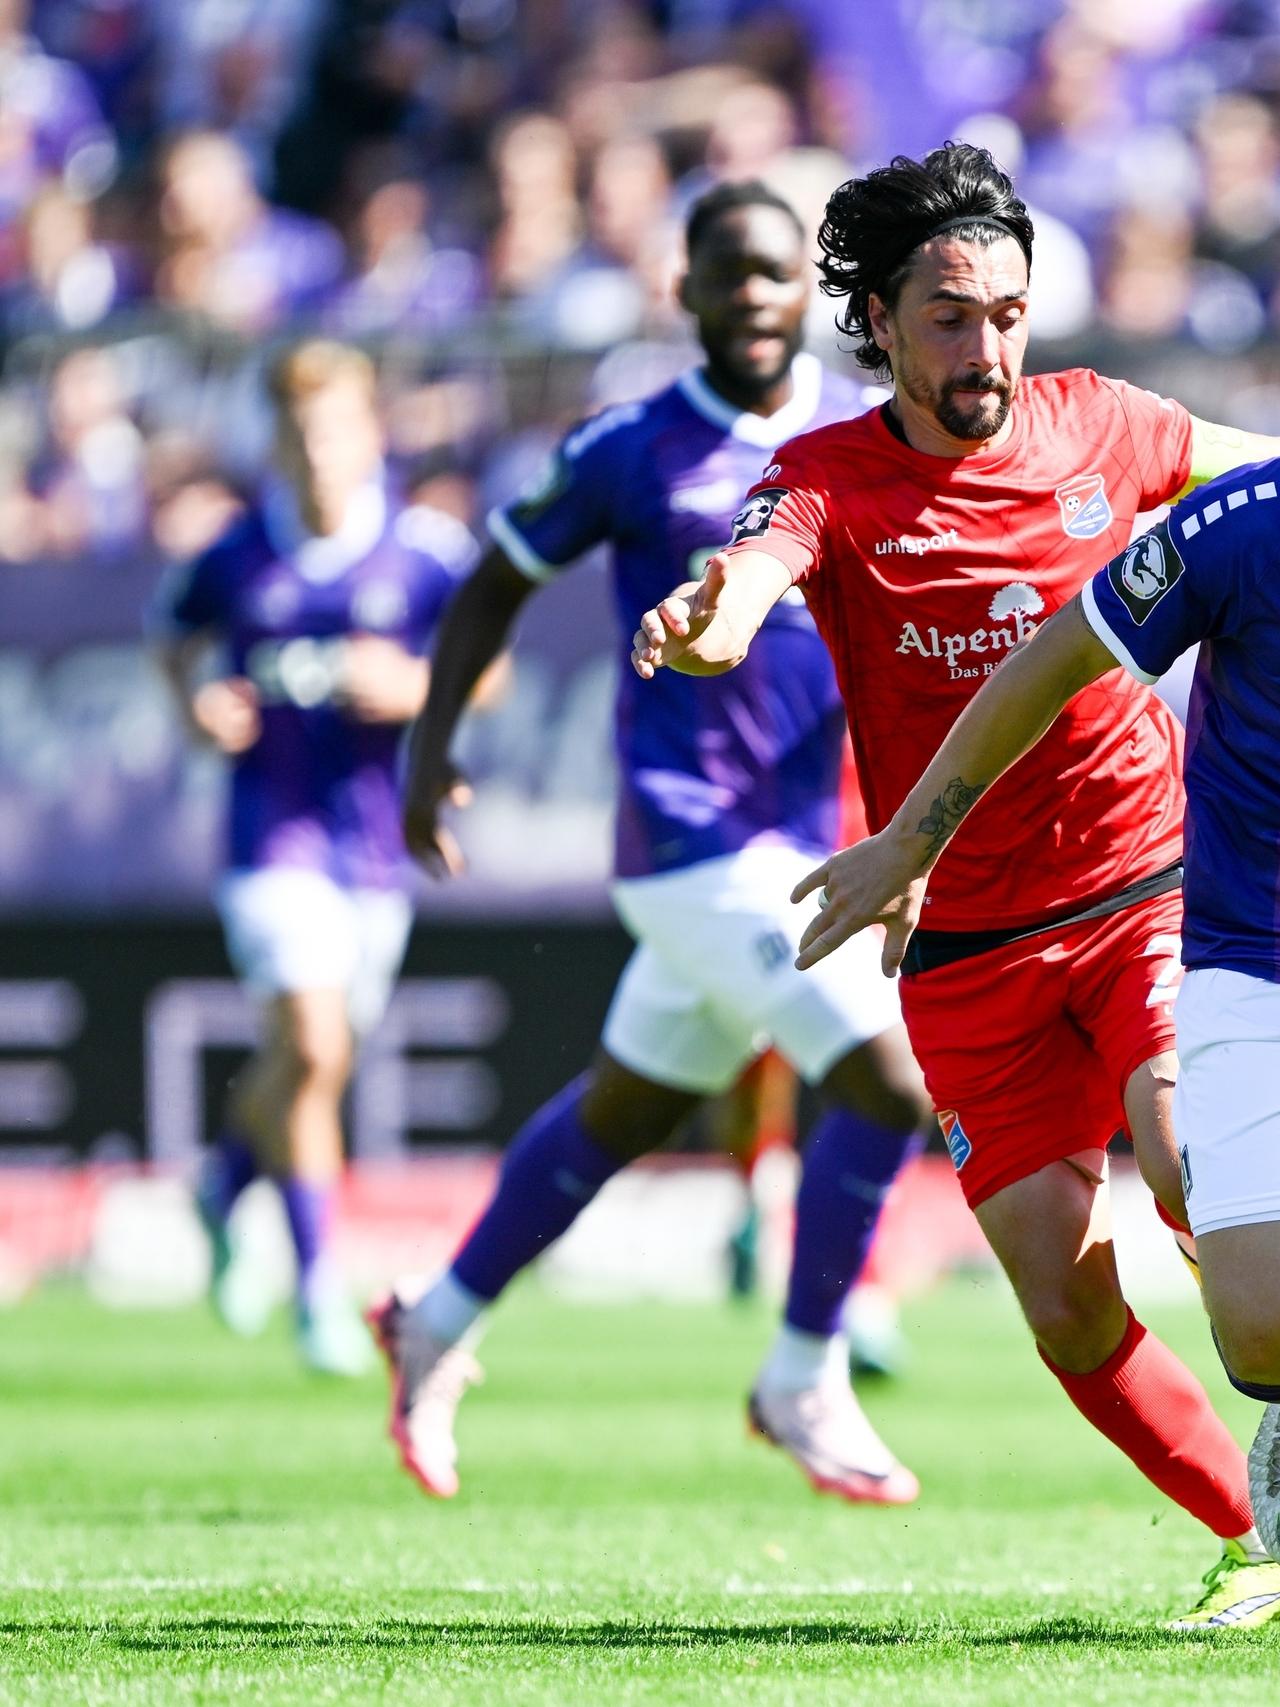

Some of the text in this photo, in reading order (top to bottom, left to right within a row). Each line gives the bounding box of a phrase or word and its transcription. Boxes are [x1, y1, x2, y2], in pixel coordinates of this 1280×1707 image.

[875, 527, 960, 556] uhlsport
[895, 617, 1038, 667] Alpenh
[949, 667, 979, 680] Das
